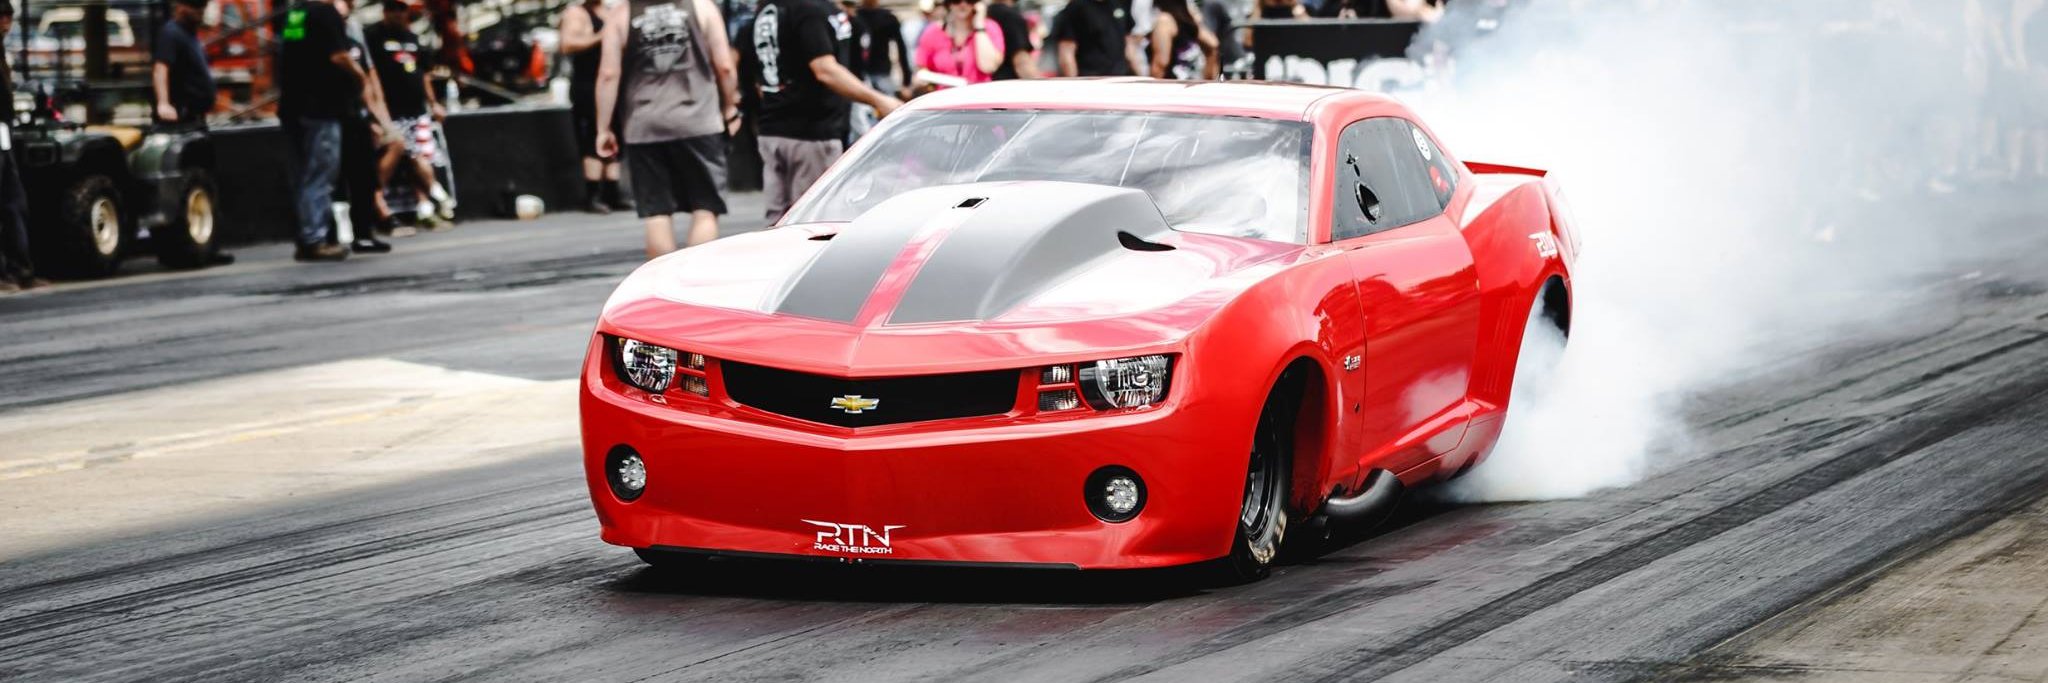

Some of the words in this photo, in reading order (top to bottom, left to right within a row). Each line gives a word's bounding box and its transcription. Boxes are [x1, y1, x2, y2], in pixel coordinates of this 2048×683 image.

[800, 519, 907, 547] RTN
[814, 543, 839, 552] RACE
[841, 545, 858, 553] THE
